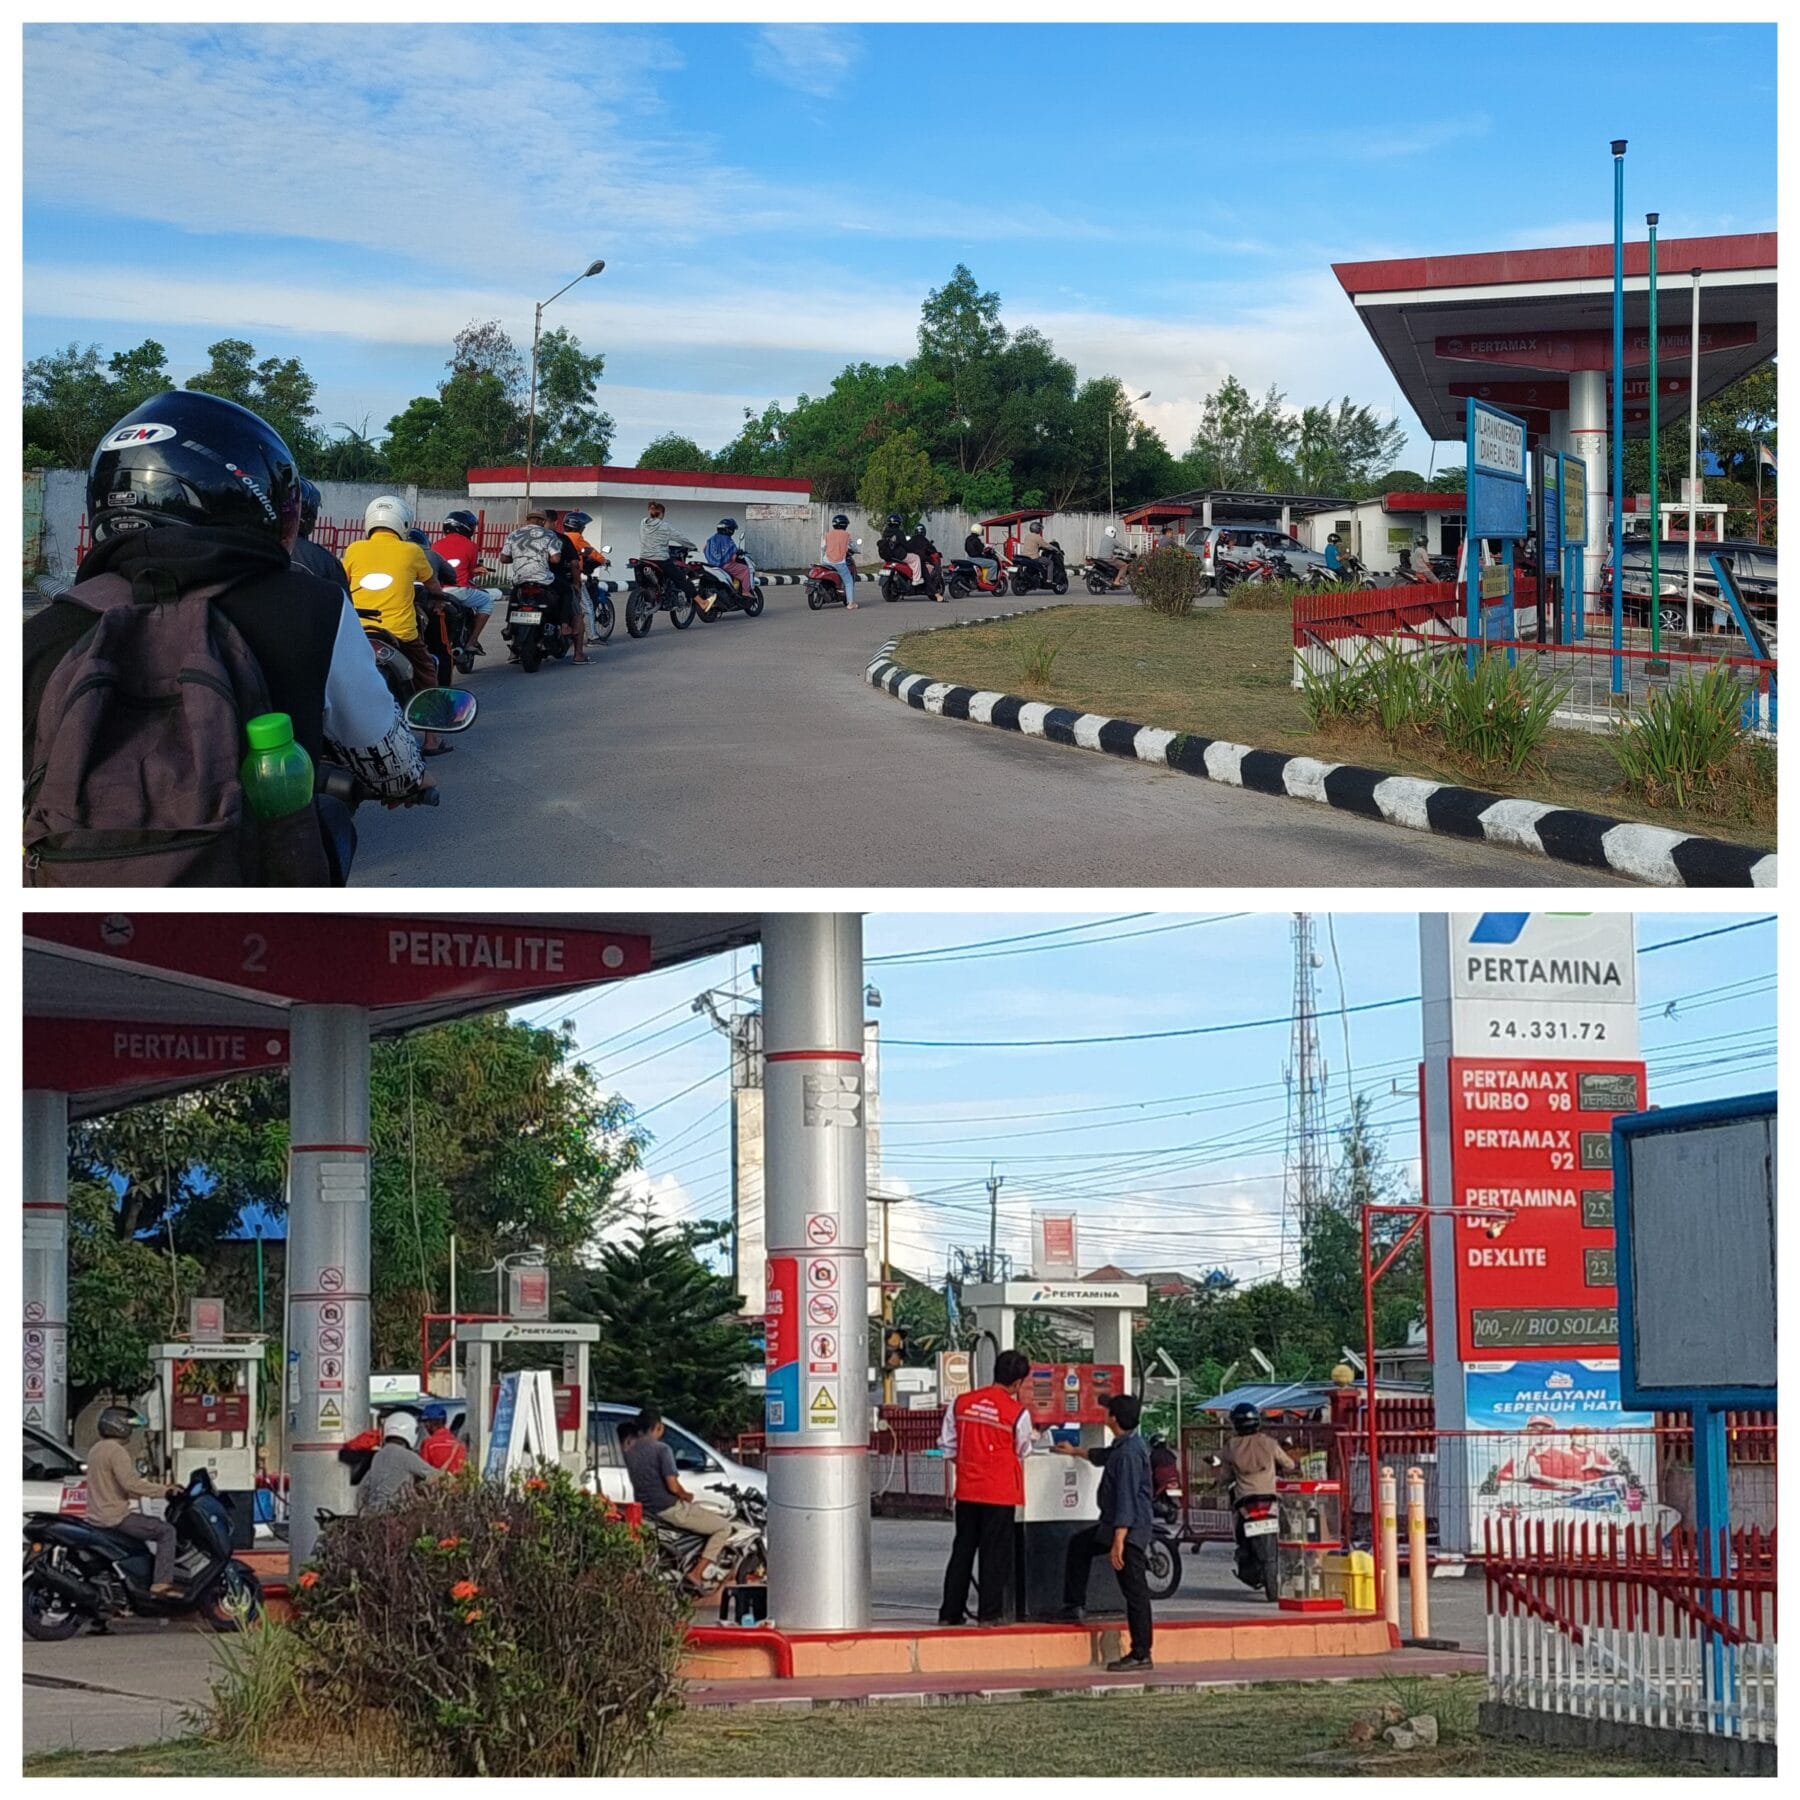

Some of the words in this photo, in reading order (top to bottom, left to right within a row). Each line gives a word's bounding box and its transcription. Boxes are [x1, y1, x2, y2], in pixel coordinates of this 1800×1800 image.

[1470, 338, 1538, 353] PERTAMAX
[114, 428, 160, 442] GM
[241, 933, 268, 972] 2
[388, 930, 565, 972] PERTALITE
[1467, 957, 1622, 986] PERTAMINA
[1489, 1020, 1606, 1040] 24.331.72
[113, 1031, 247, 1060] PERTALITE
[1462, 1070, 1569, 1090] PERTAMAX
[1463, 1092, 1530, 1111] TURBO
[1548, 1093, 1572, 1112] 98
[1463, 1129, 1572, 1149] PERTAMAX
[1586, 1142, 1613, 1160] 16.
[1550, 1152, 1575, 1170] 92
[1466, 1188, 1578, 1208] PERTAMINA
[1467, 1248, 1547, 1267] DEXLITE
[1052, 1291, 1120, 1299] PERTAMINA
[521, 1327, 578, 1335] PERTAMINA
[1527, 1318, 1559, 1335] BIO
[1561, 1316, 1619, 1335] SOLAR
[1515, 1389, 1607, 1401] MELAYANI
[1492, 1401, 1576, 1414] SEPENUH
